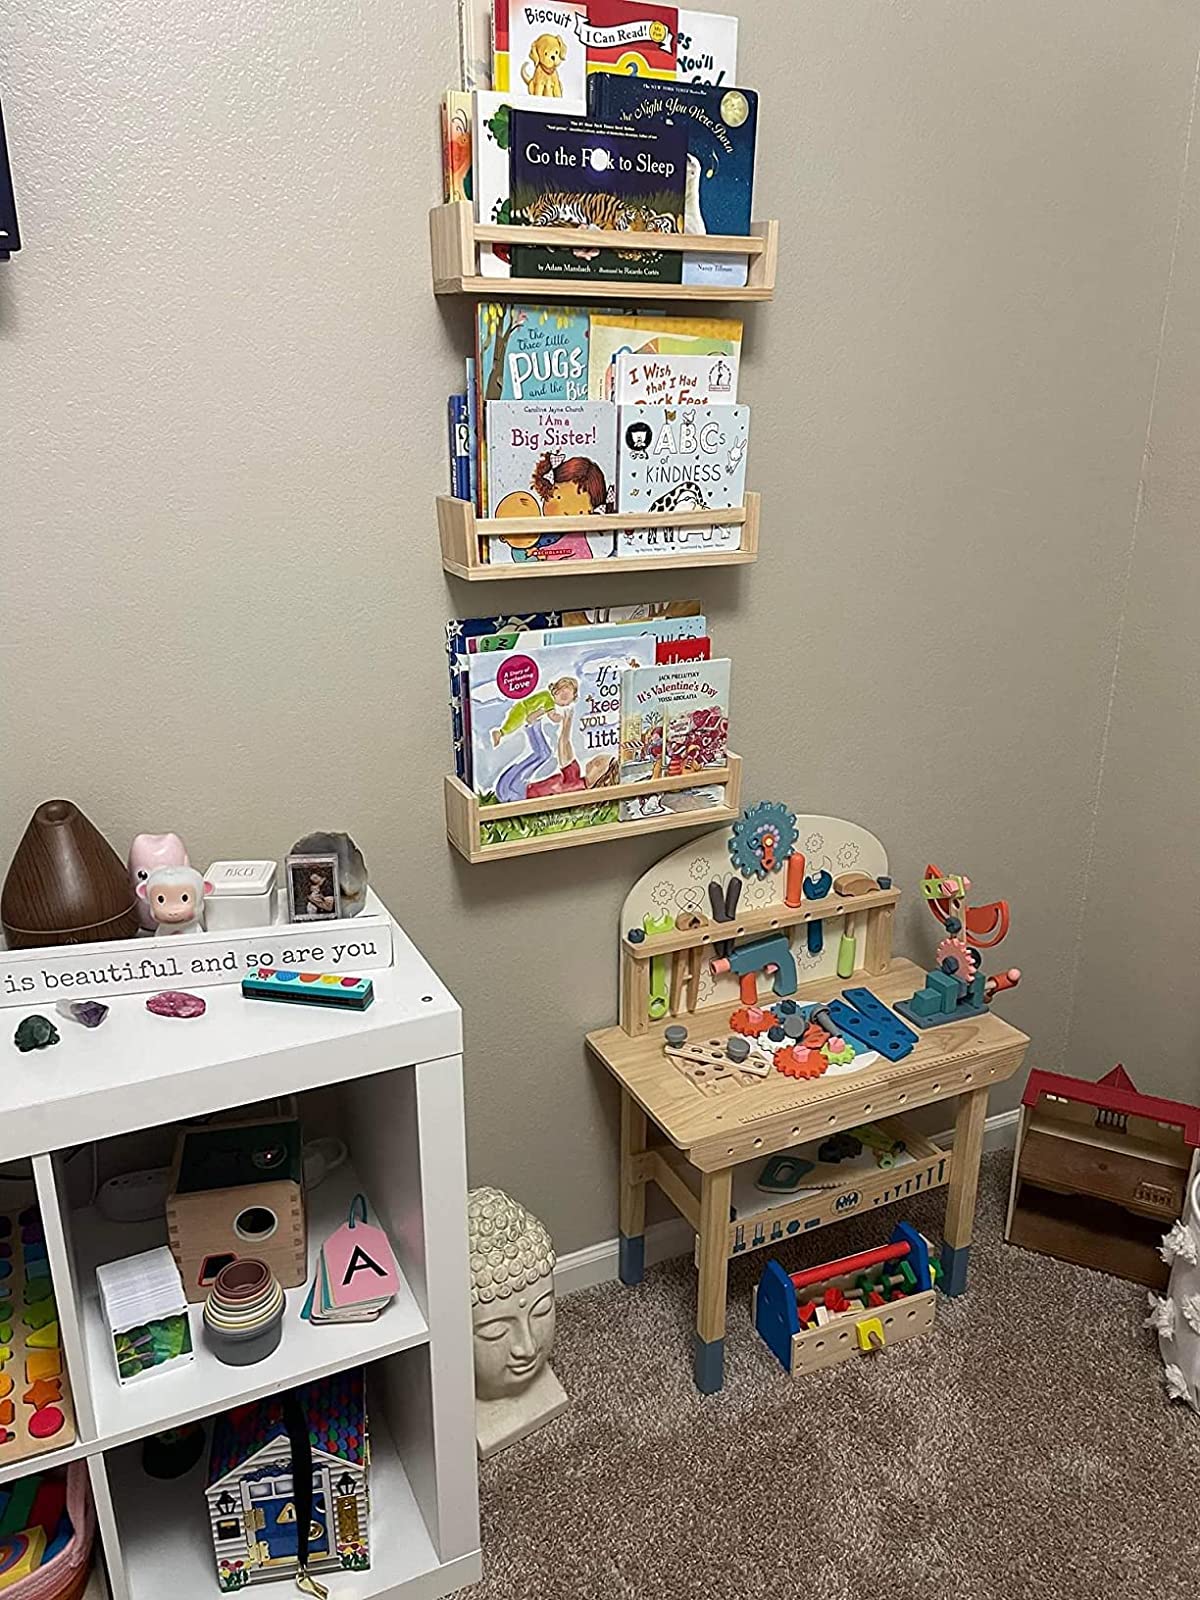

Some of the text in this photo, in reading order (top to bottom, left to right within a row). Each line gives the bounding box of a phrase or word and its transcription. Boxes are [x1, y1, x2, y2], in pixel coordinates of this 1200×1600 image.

[524, 8, 572, 28] Biscuit
[586, 26, 648, 44] I Can Read!
[677, 54, 713, 73] You'll
[634, 98, 662, 119] Night
[665, 97, 687, 116] You
[688, 105, 713, 128] Were
[711, 123, 735, 153] Born
[525, 143, 675, 177] Go the Fk to Sleep
[544, 262, 562, 272] Adam
[517, 334, 570, 351] Three Little
[528, 328, 544, 340] The
[508, 347, 586, 400] PUGS
[629, 362, 671, 385] I Wish
[529, 383, 547, 397] and
[550, 381, 563, 393] the
[646, 375, 697, 395] that I Had
[524, 405, 584, 414] Caroline Jayne Church
[539, 415, 543, 426] I
[545, 414, 562, 426] Am
[511, 426, 596, 450] Big Sister!
[653, 422, 727, 455] ABCs
[660, 456, 669, 464] of
[509, 680, 530, 691] Love
[596, 665, 611, 687] If
[637, 681, 718, 703] It's Valentine's Day
[580, 715, 607, 731] you
[4, 941, 377, 994] is beautiful and so are you
[342, 1245, 388, 1285] A
